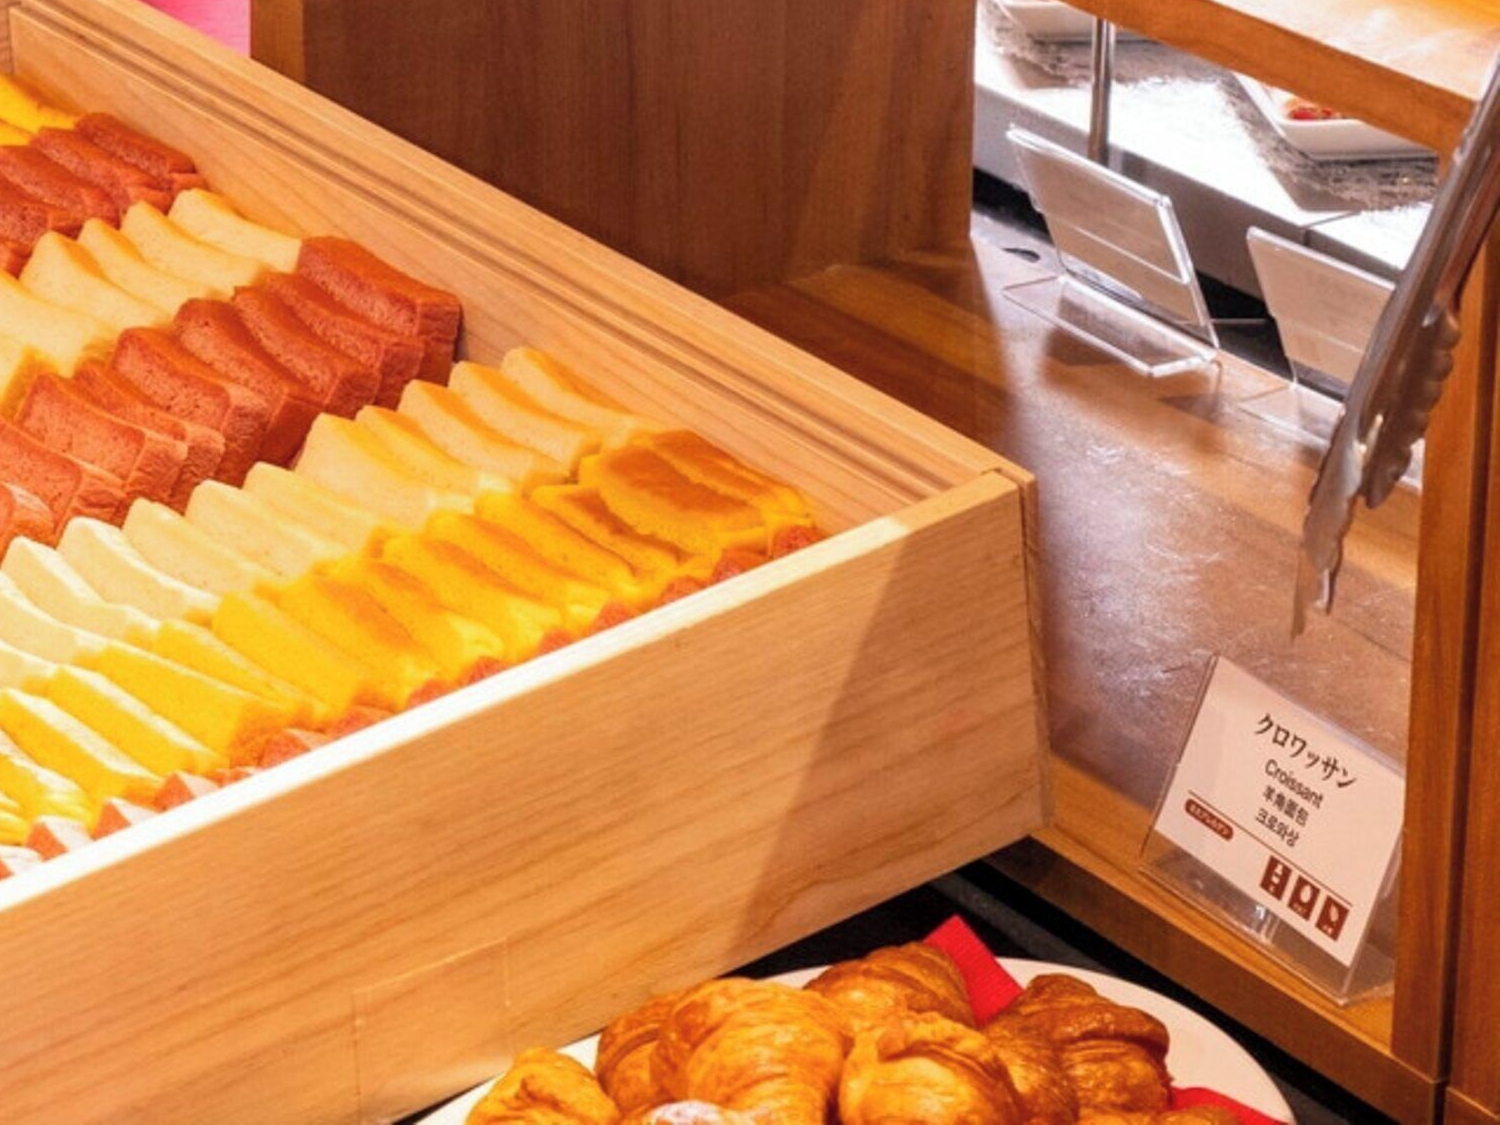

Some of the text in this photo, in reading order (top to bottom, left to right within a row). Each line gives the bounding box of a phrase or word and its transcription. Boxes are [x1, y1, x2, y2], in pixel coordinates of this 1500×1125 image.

[1254, 713, 1358, 789] クロワッサン
[1265, 759, 1324, 809] Croissant
[1255, 807, 1300, 848] 크로와상
